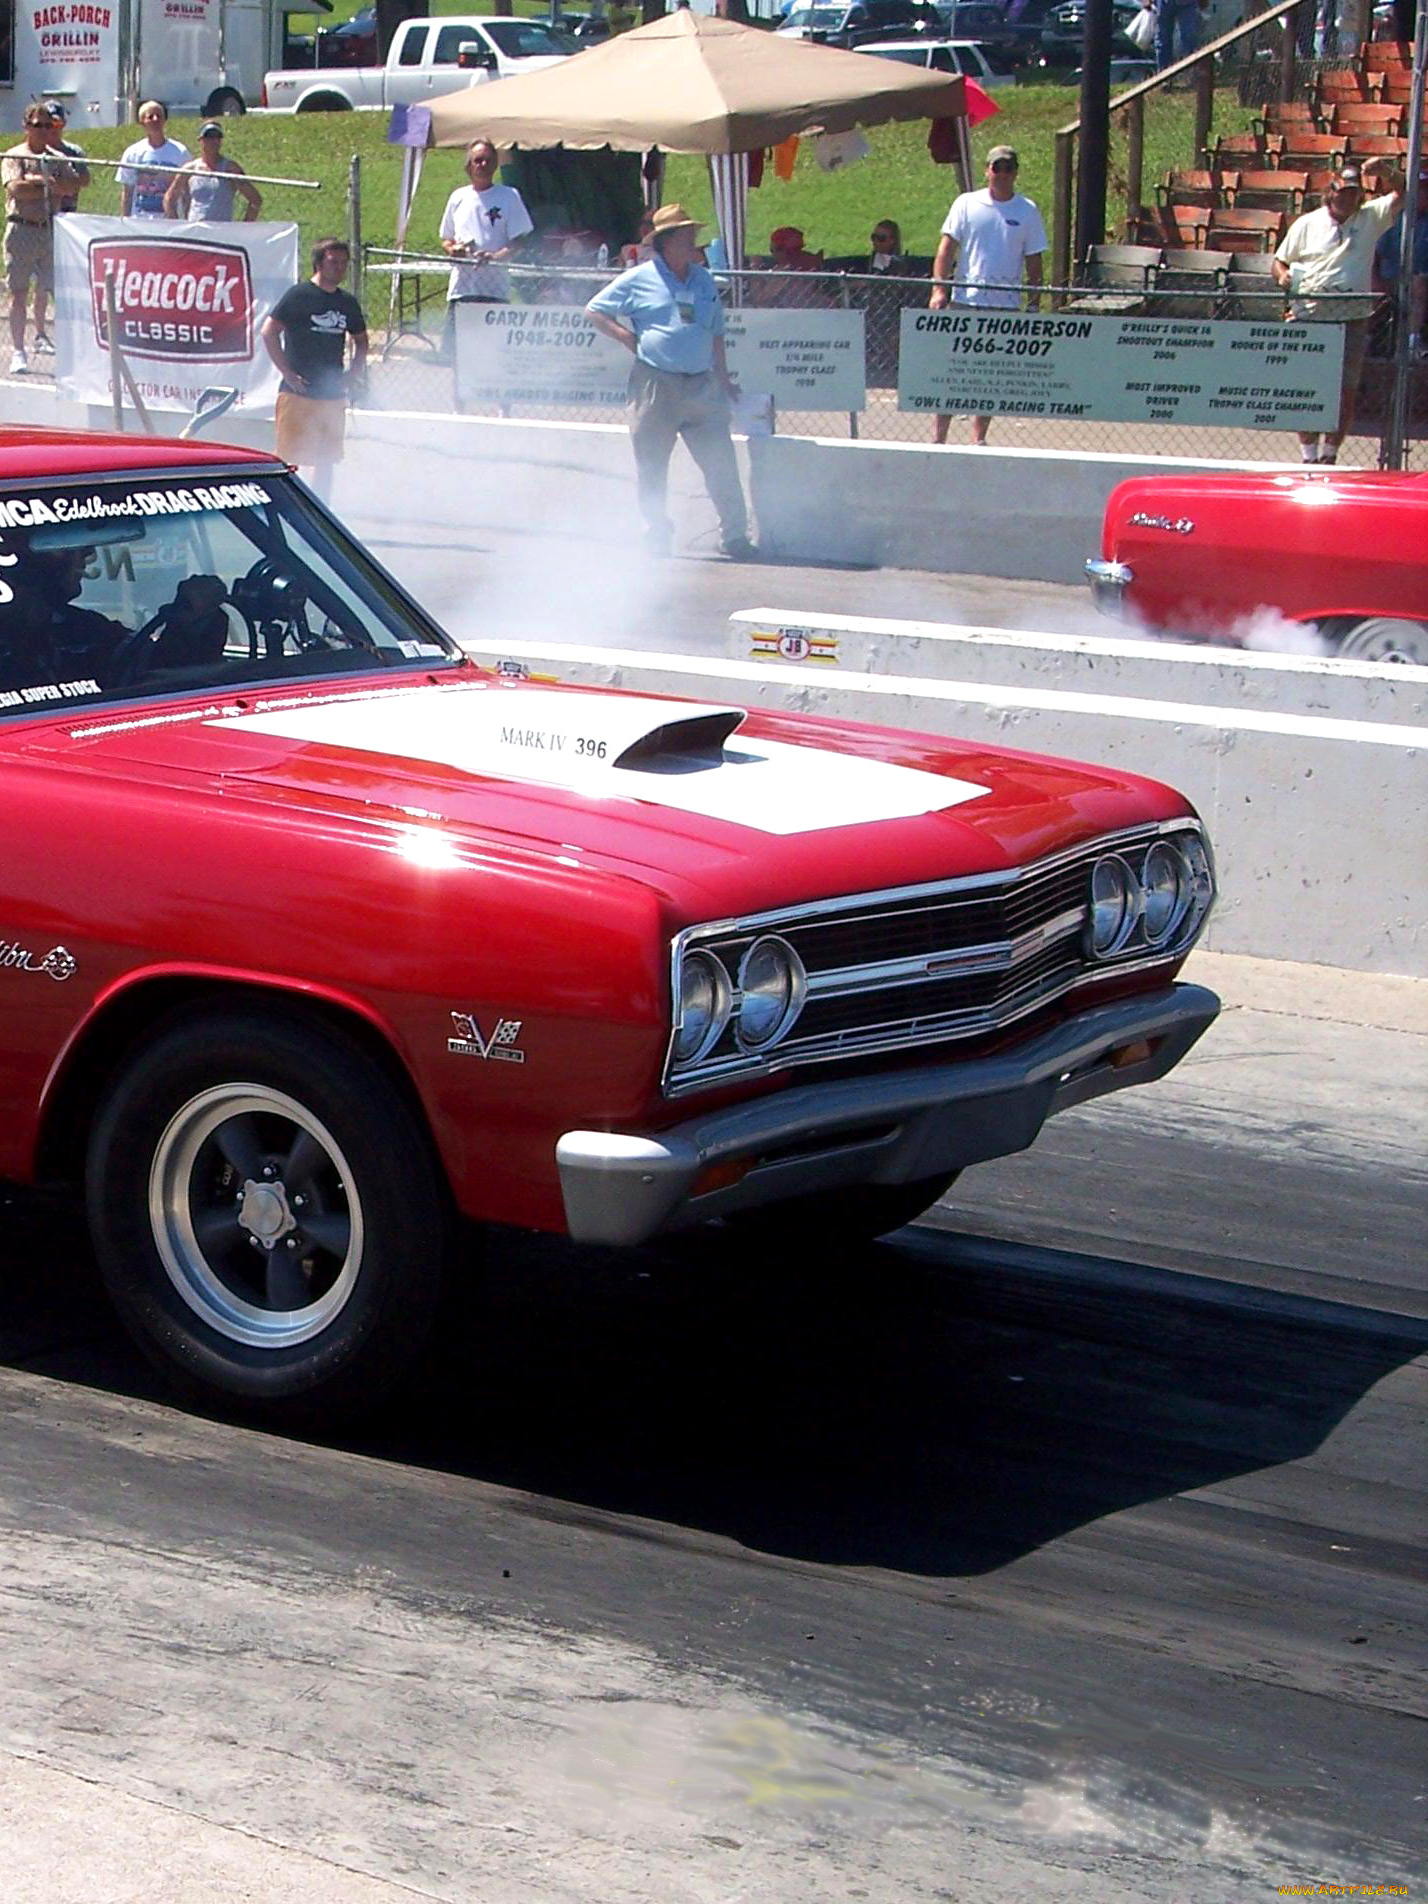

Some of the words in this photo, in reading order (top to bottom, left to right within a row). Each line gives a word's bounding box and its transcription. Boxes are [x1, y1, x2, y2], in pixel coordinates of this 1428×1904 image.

[33, 5, 111, 30] BACK-PORCH
[41, 32, 99, 47] GRILLIN
[484, 310, 528, 327] GARY
[915, 315, 971, 333] CHRIS
[976, 318, 1092, 338] THOMERSON
[1171, 325, 1199, 335] QUICK
[1250, 328, 1280, 338] BEECH
[1281, 328, 1307, 338] BEND
[952, 337, 1053, 356] 1966-2007
[1116, 336, 1164, 347] SHOOTOUT
[1165, 338, 1215, 348] CHAMPION
[1231, 340, 1265, 350] ROOKIE
[1267, 341, 1280, 350] OF
[1281, 342, 1301, 351] THE
[1301, 343, 1325, 353] YEAR
[1125, 382, 1151, 392] MOST
[1153, 383, 1201, 394] IMPROVED
[1218, 386, 1248, 396] MUSIC
[1250, 388, 1270, 397] CITY
[1273, 388, 1317, 399] RACEWAY
[945, 398, 995, 411] HEADED
[999, 399, 1045, 413] RACING
[1145, 396, 1179, 406] DRIVER
[1209, 399, 1243, 410] TROPHY
[1245, 401, 1274, 411] CLASS
[1275, 402, 1324, 412] CHAMPION
[53, 495, 143, 522] Edelbrock
[133, 489, 203, 516] DRAG
[193, 481, 272, 511] RACING
[20, 684, 62, 703] SUPER
[59, 679, 102, 697] STOCK
[500, 726, 545, 750] MARK
[550, 733, 567, 751] IV
[574, 738, 608, 759] 396
